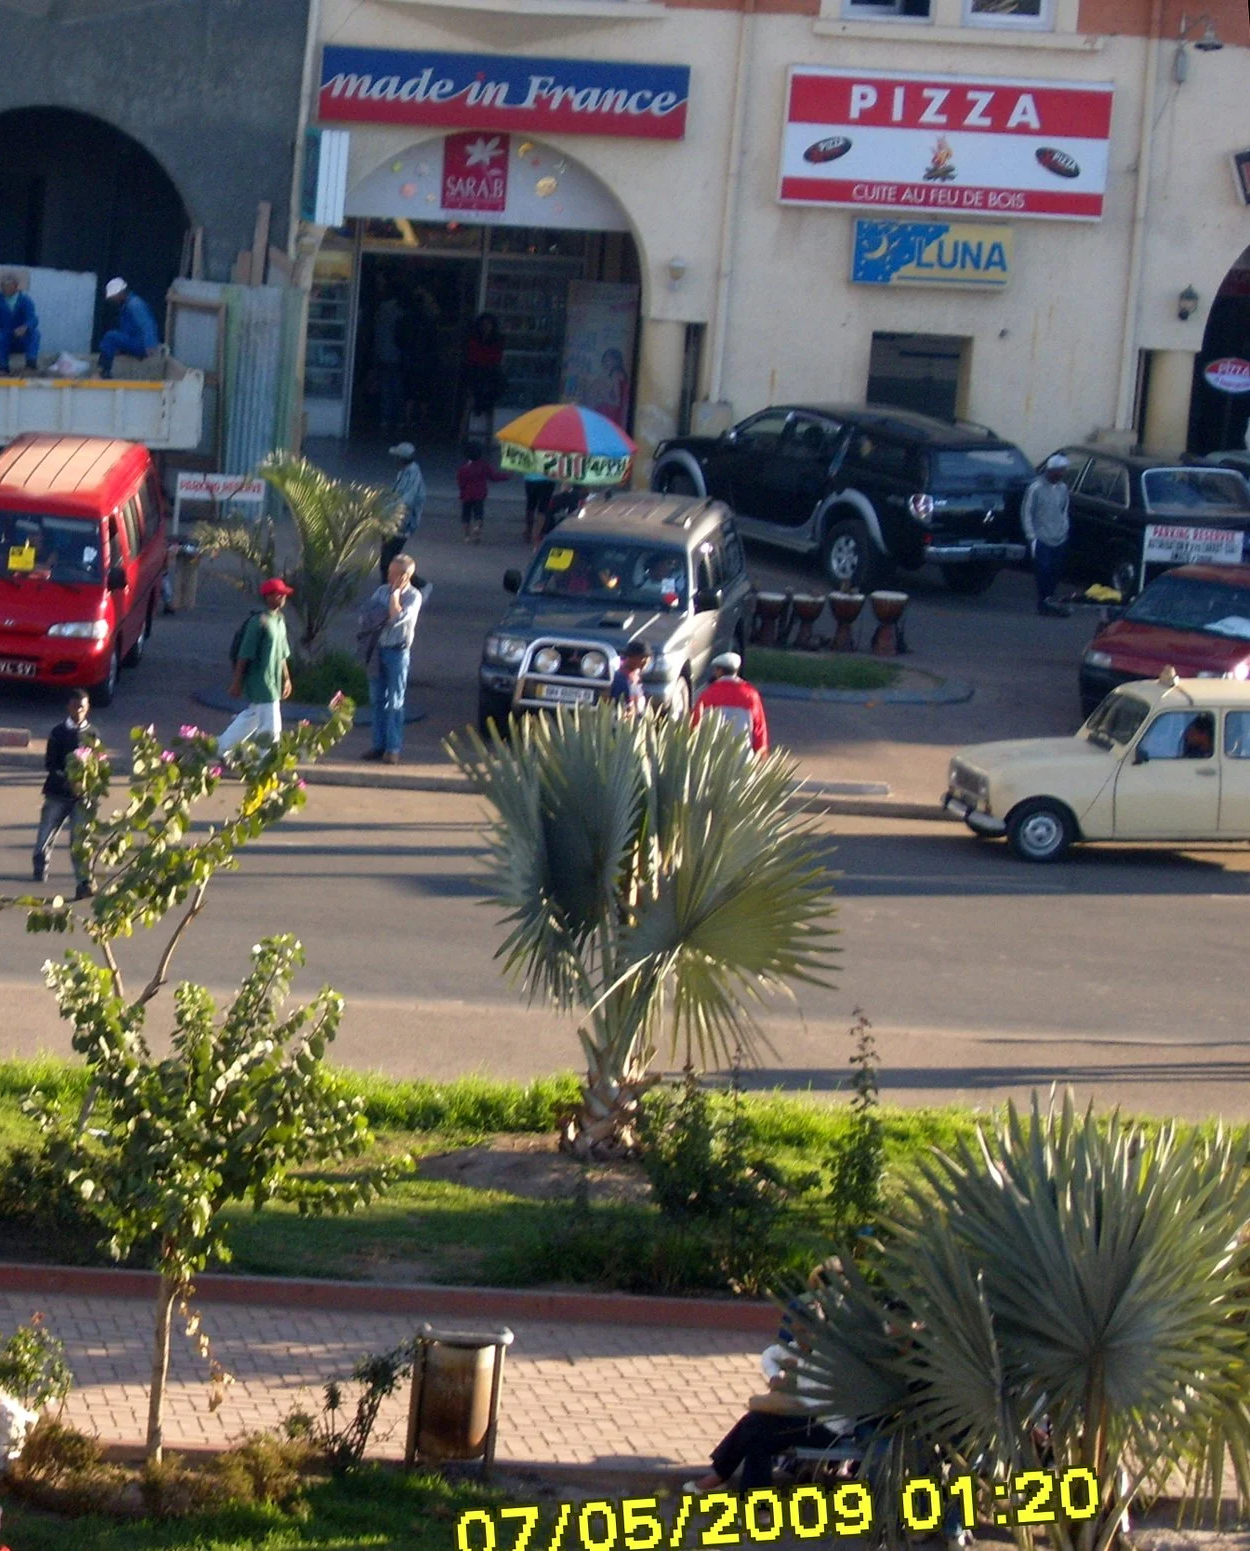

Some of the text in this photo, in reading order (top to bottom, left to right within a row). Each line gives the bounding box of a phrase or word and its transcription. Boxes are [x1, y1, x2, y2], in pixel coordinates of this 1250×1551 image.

[321, 67, 688, 117] made in France
[849, 83, 1042, 130] PIZZA
[852, 183, 1026, 209] CUITE AU FEU DE BOIS
[915, 237, 1008, 273] LUNA
[180, 480, 221, 493] PARKING
[1152, 526, 1189, 539] PARKING
